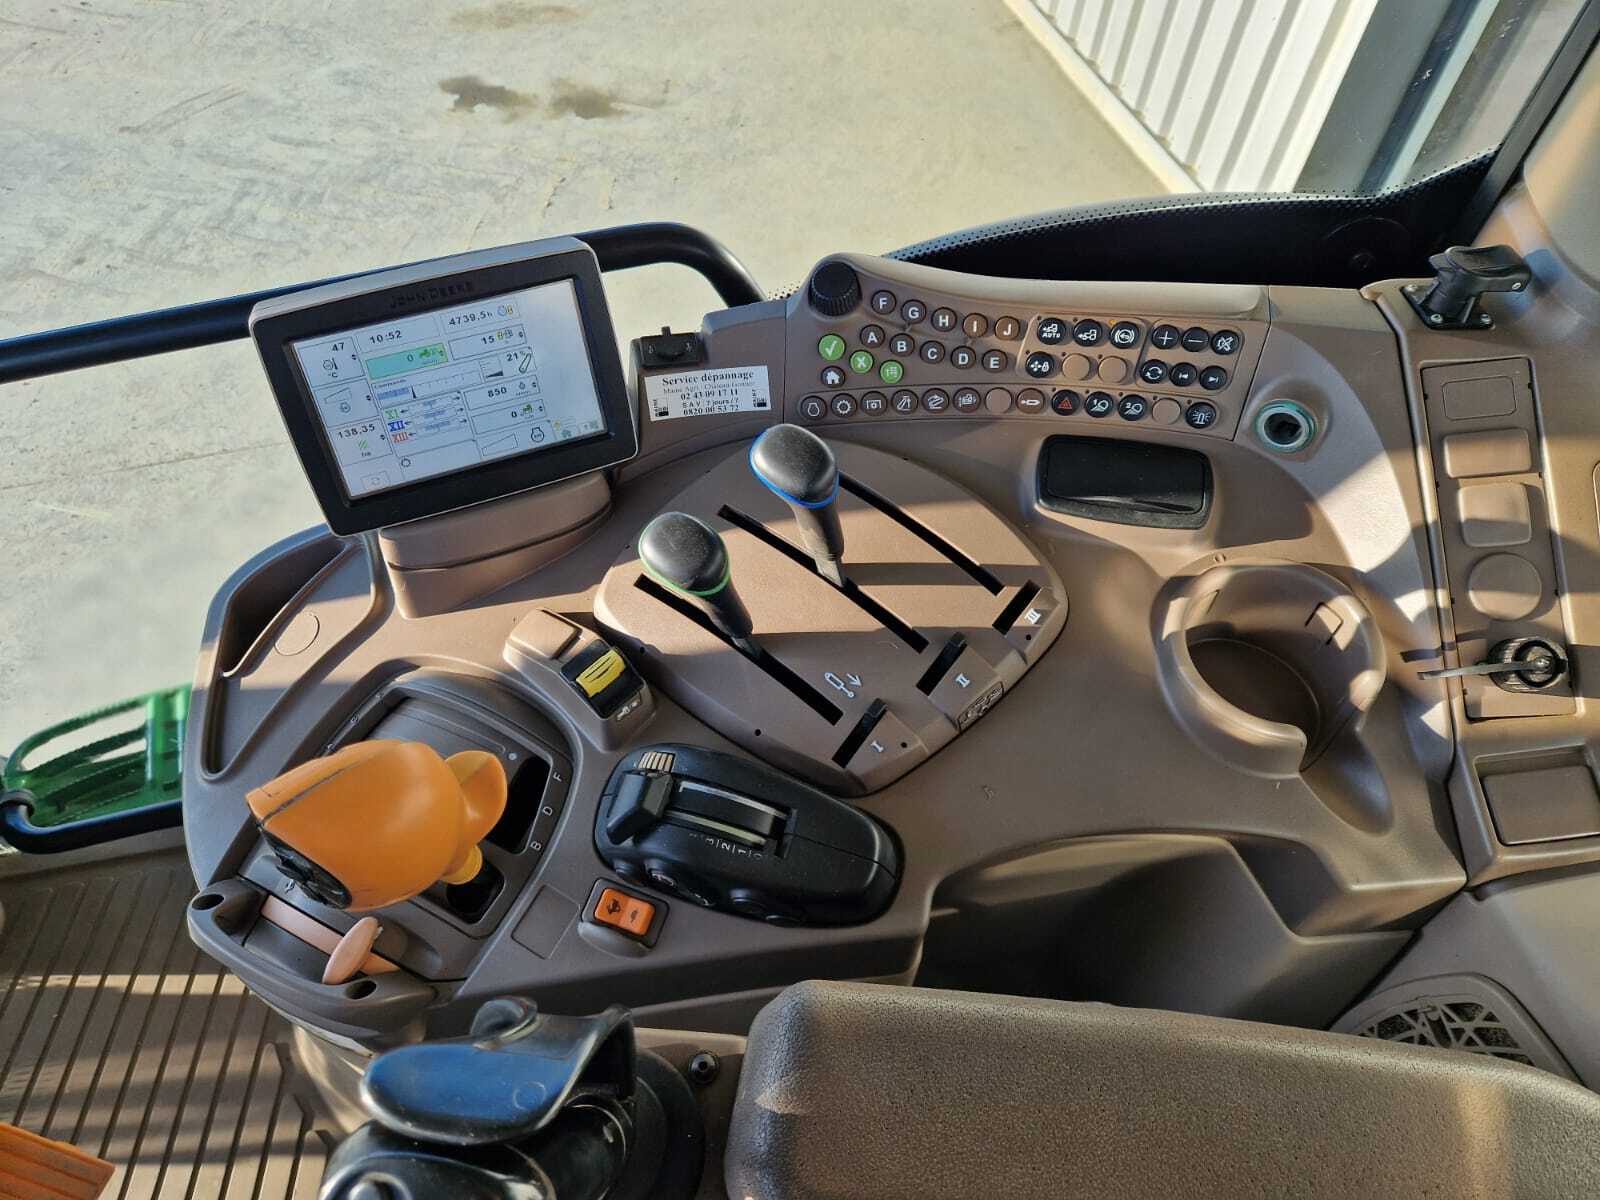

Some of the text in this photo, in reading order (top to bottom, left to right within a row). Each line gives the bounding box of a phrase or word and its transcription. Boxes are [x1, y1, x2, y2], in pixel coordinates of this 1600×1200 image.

[879, 297, 888, 309] F
[908, 307, 920, 319] G
[939, 315, 949, 328] H
[972, 320, 978, 333] I
[1003, 323, 1012, 336] J
[369, 329, 402, 344] 10:52
[481, 335, 495, 345] 15
[867, 332, 878, 343] A
[332, 342, 345, 352] 47
[897, 341, 907, 352] B
[927, 348, 937, 360] C
[959, 353, 969, 365] D
[990, 357, 1000, 369] E
[662, 376, 698, 385] Service
[487, 386, 507, 398] 850
[388, 420, 405, 433] XII
[552, 771, 562, 782] F
[543, 806, 553, 816] D
[530, 841, 542, 852] B
[721, 842, 730, 851] 2
